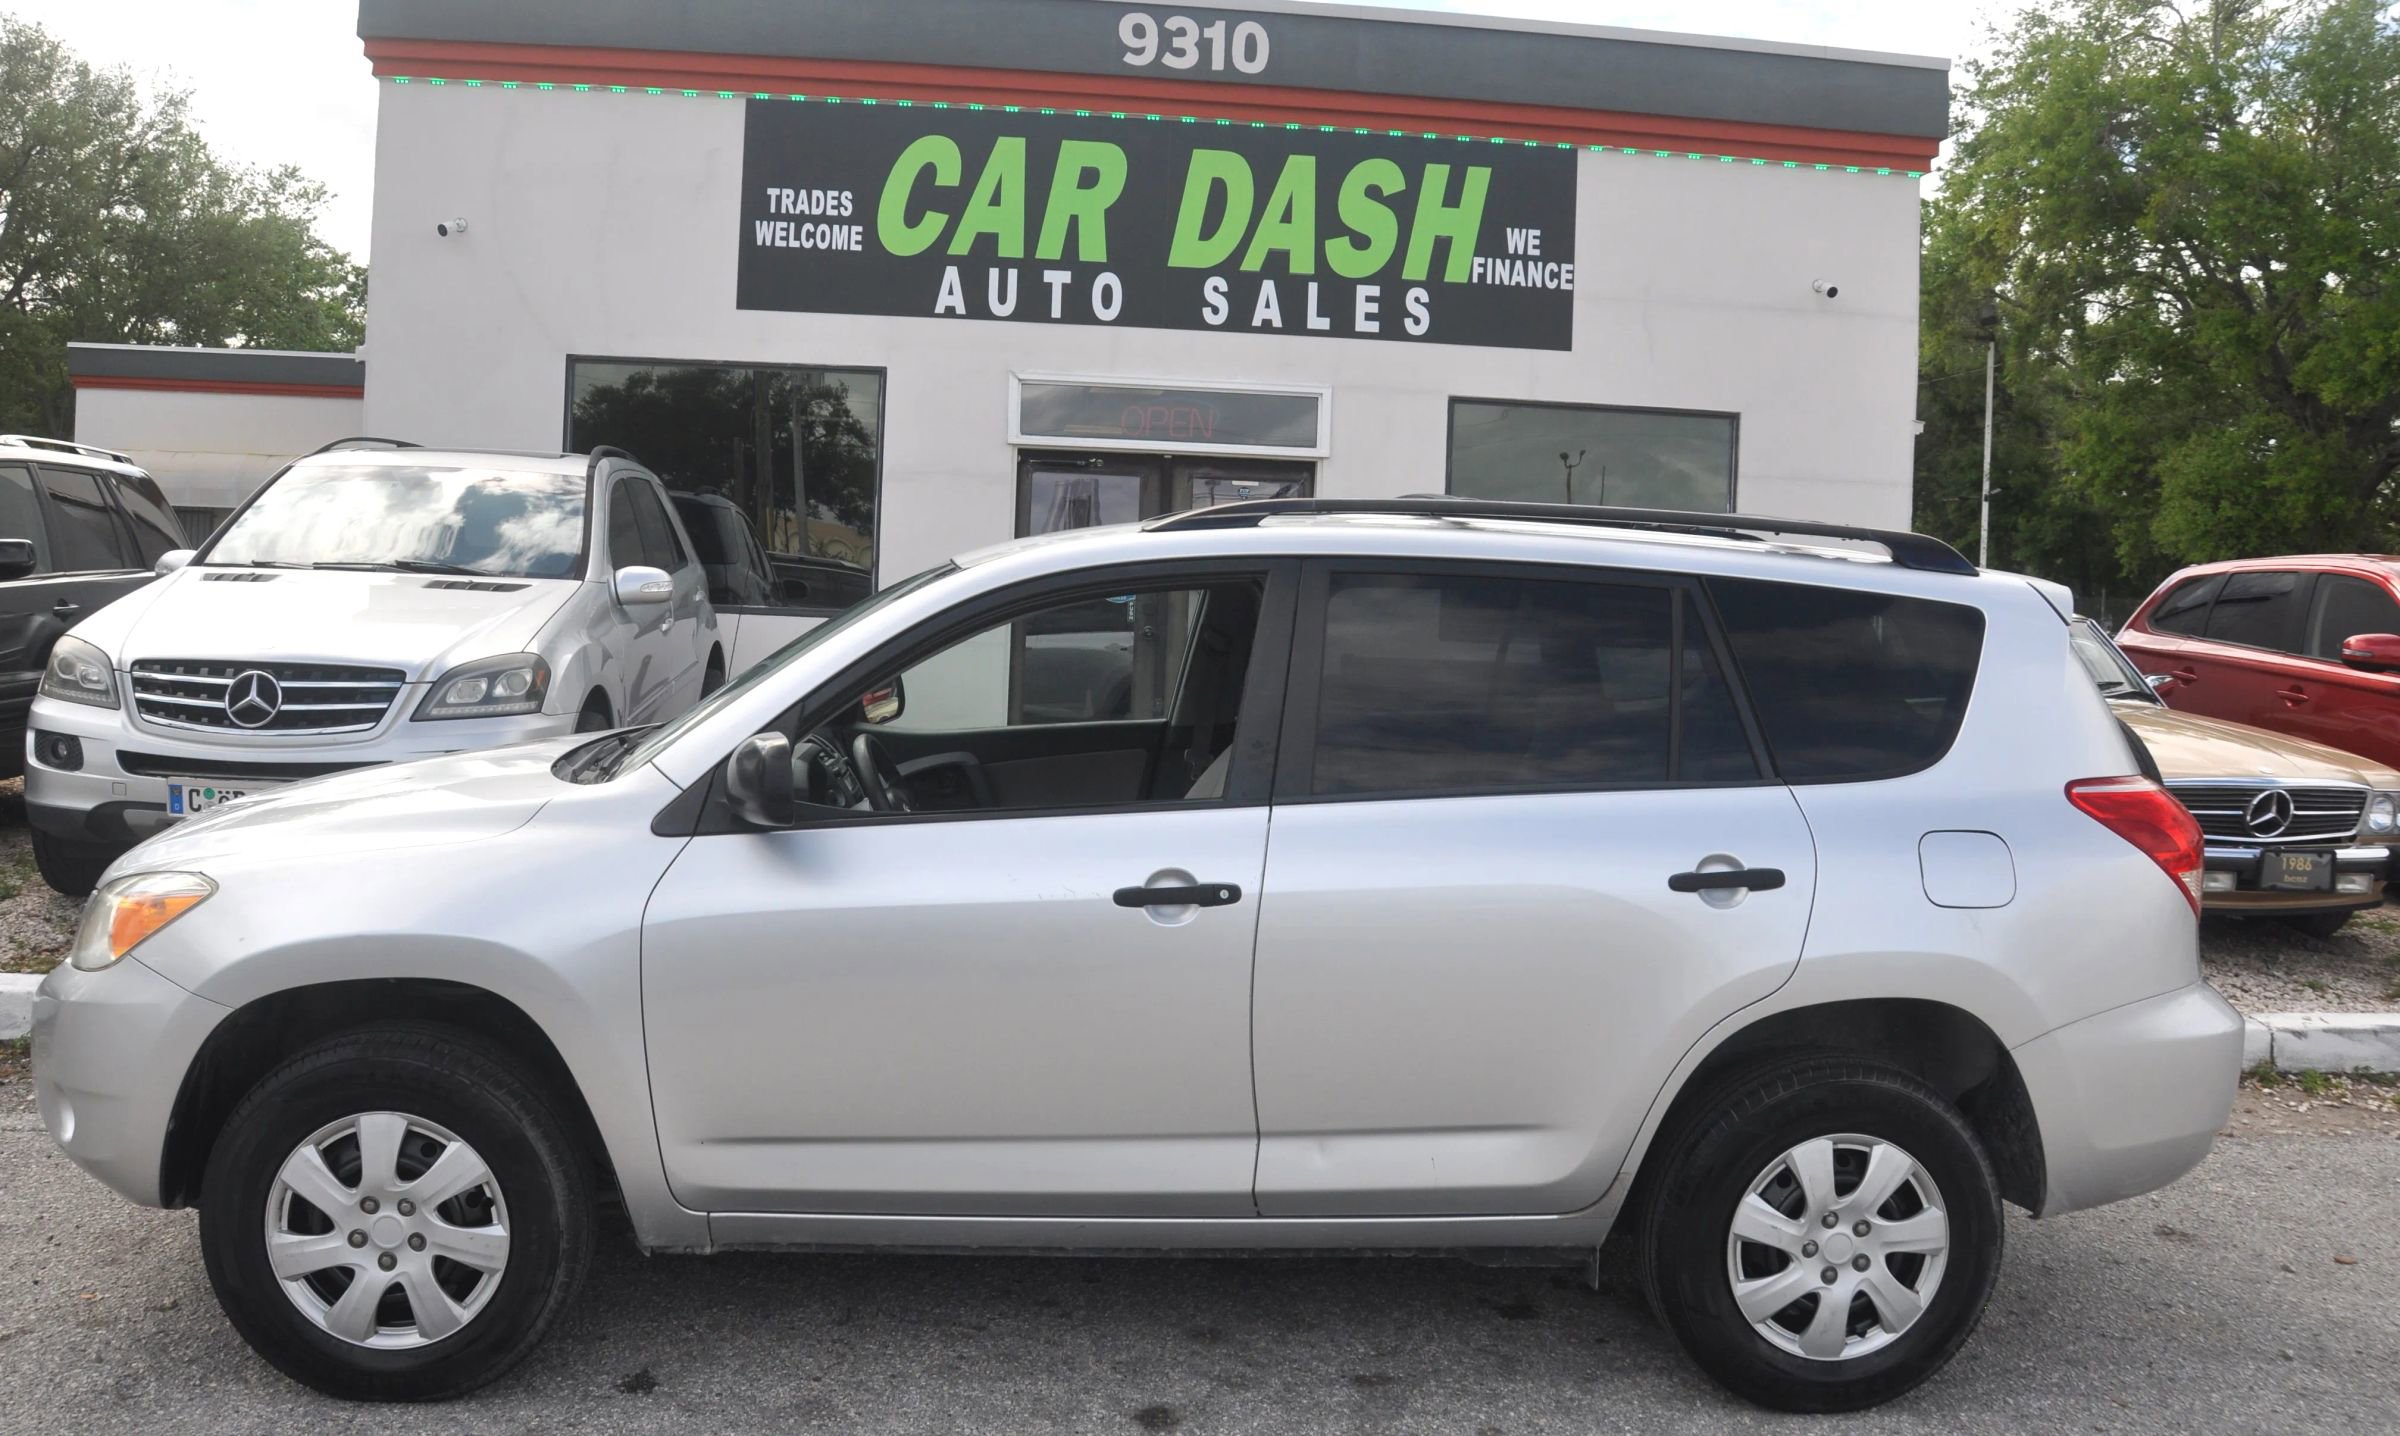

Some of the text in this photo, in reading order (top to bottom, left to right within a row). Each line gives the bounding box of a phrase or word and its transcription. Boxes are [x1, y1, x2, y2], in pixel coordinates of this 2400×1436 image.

[1119, 12, 1270, 74] 9310
[766, 187, 853, 217] TRADES
[877, 134, 1493, 284] CAR DASH
[755, 220, 864, 252] WELCOME
[1506, 227, 1542, 256] WE
[1472, 256, 1575, 290] FINANCE
[934, 265, 1431, 336] AUTO SALES
[1121, 404, 1214, 439] OPEN
[2282, 857, 2313, 871] 1986
